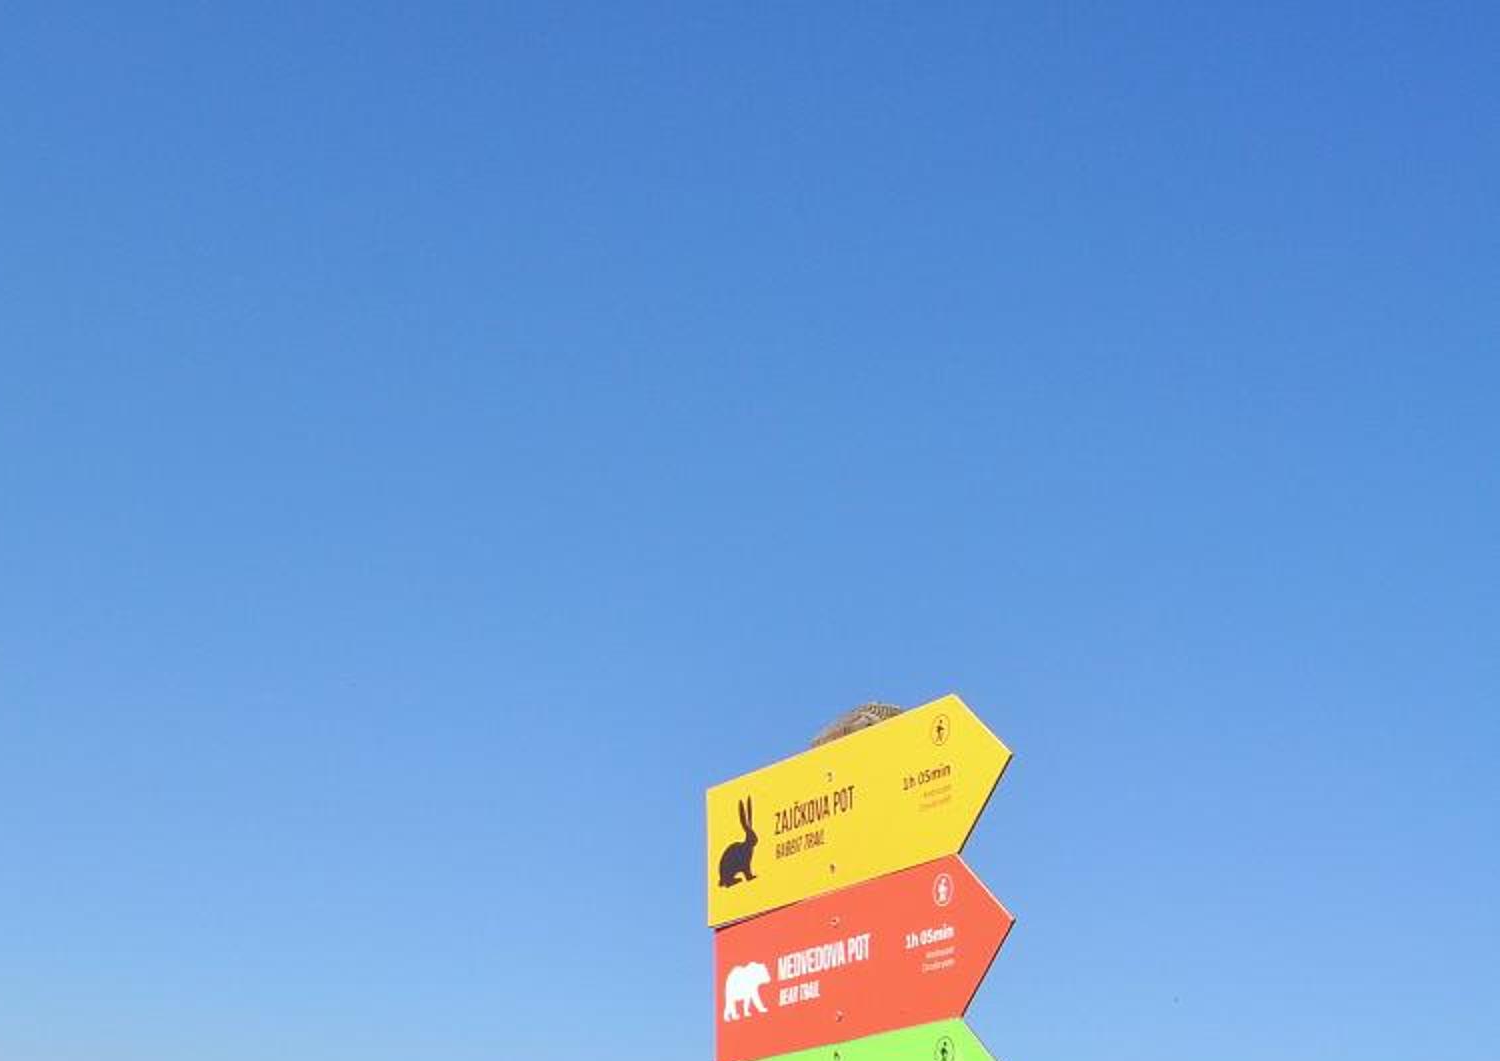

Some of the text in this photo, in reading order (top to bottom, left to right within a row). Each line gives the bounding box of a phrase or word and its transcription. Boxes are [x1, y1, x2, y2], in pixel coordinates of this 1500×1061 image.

[918, 763, 950, 784] 05min
[775, 785, 855, 835] ZAJČKOVA POT
[905, 923, 954, 949] 1h 05min
[778, 933, 870, 981] MEDVEDOVA POT
